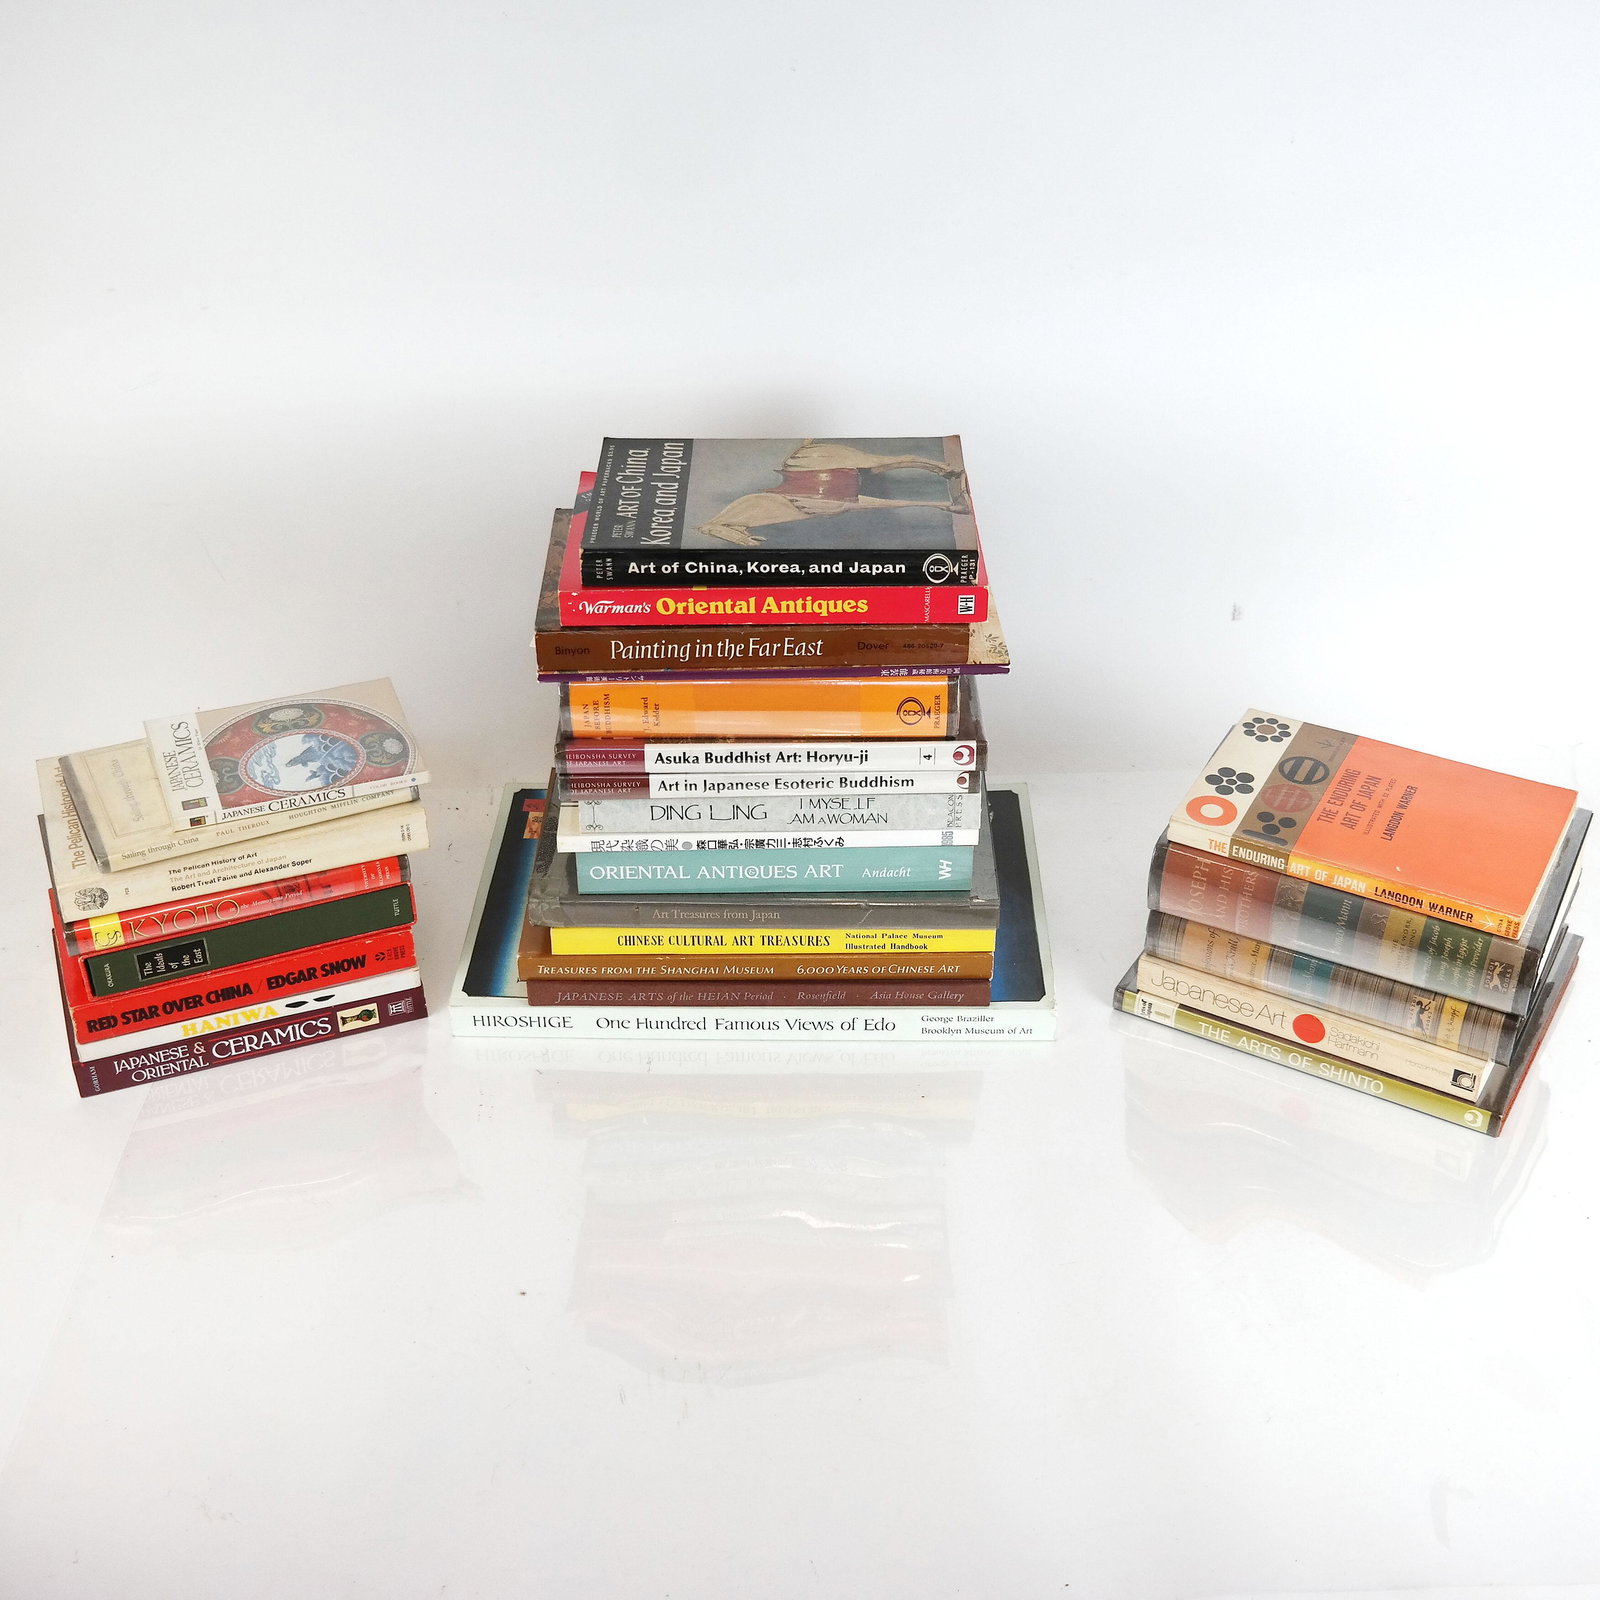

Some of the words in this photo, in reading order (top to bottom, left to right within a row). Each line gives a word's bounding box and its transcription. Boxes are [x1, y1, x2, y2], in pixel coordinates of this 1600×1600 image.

[615, 447, 652, 484] China,
[652, 442, 688, 479] Japan
[622, 485, 642, 498] OF
[651, 480, 679, 505] and
[616, 499, 640, 518] ART
[611, 523, 624, 538] PETER
[640, 507, 678, 545] Korea,
[596, 559, 604, 579] PETER
[606, 557, 614, 581] SWANN
[628, 561, 656, 574] Art
[661, 561, 679, 574] of
[685, 561, 743, 576] China,
[747, 561, 805, 576] Korea,
[809, 561, 843, 574] and
[849, 561, 906, 576] Japan
[960, 554, 968, 583] PRAEGER
[578, 600, 652, 615] Warman's
[656, 597, 756, 616] Oriental
[761, 596, 869, 617] Antiques
[555, 645, 590, 656] Binyon
[610, 639, 690, 662] Painting
[694, 639, 712, 658] in
[716, 638, 744, 660] the
[748, 637, 781, 657] Far
[783, 637, 824, 658] East
[857, 641, 889, 651] Dover
[583, 702, 591, 728] JAPAN
[608, 752, 637, 760] SURVEY
[654, 751, 700, 765] Asuka
[704, 751, 771, 765] Buddhist
[775, 751, 802, 763] Art:
[806, 750, 869, 766] Horyu-ji
[657, 780, 680, 792] Art
[683, 780, 698, 792] in
[702, 779, 770, 794] Japanese
[774, 776, 835, 790] Esoteric
[839, 775, 915, 789] Buddhism
[1326, 768, 1361, 806] ENDURING
[1356, 774, 1382, 801] JAPAN
[221, 805, 265, 821] JAPANESE
[268, 788, 346, 812] CERAMICS
[650, 804, 702, 822] DING
[710, 804, 768, 822] LING
[808, 797, 876, 810] MYSELF
[1349, 799, 1368, 812] OF
[1380, 810, 1405, 842] LANGDON
[1396, 784, 1418, 810] WARNER
[787, 813, 815, 825] AM
[827, 812, 888, 825] WOMAN
[1316, 805, 1339, 824] THE
[1340, 811, 1361, 831] ART
[67, 815, 83, 850] Pelican
[216, 828, 234, 837] PAUL
[238, 820, 270, 833] THEROUX
[121, 849, 146, 861] Sailing
[147, 841, 176, 853] through
[177, 835, 199, 846] China
[72, 851, 87, 870] The
[168, 867, 182, 876] The
[183, 861, 210, 873] Pelican
[211, 856, 237, 867] History
[237, 854, 245, 862] of
[246, 852, 258, 860] Art
[171, 881, 196, 892] Robert
[253, 863, 290, 876] Alexander
[291, 858, 313, 869] Soper
[590, 865, 690, 881] ORIENTAL
[697, 865, 798, 880] ANTIQUES
[804, 864, 844, 878] ART
[862, 867, 911, 878] Andacht
[1208, 838, 1228, 855] THE
[1231, 845, 1285, 870] ENDURING
[1289, 862, 1312, 878] ART
[1314, 869, 1329, 881] OF
[1332, 873, 1367, 893] JAPAN
[1373, 885, 1424, 909] LANGDON
[1428, 901, 1474, 923] WARNER
[1222, 866, 1234, 891] HIS
[130, 899, 240, 941] KYOTO
[652, 909, 669, 919] Art
[671, 908, 721, 919] Treasures
[723, 908, 748, 919] from
[749, 909, 780, 922] Japan
[617, 935, 664, 947] CHINESE
[668, 935, 727, 947] CULTURAL
[731, 935, 755, 947] ART
[761, 935, 830, 947] TREASURES
[881, 932, 908, 940] Palace
[912, 932, 944, 940] Museum
[154, 952, 166, 973] Ideals
[171, 961, 179, 970] of
[183, 953, 191, 967] the
[193, 948, 203, 964] East
[144, 962, 153, 977] The
[796, 965, 835, 976] 6,000
[86, 1013, 119, 1034] RED
[121, 1003, 161, 1026] STAR
[161, 993, 204, 1016] OVER
[205, 982, 253, 1005] CHINA
[266, 967, 319, 991] EDGAR
[320, 954, 367, 978] SNOW
[555, 992, 623, 1003] JAPANESE
[628, 992, 664, 1002] ARTS
[667, 991, 677, 1003] of
[679, 991, 694, 1002] the
[698, 991, 741, 1002] HEIAN
[743, 991, 774, 1002] Period
[797, 990, 846, 1003] Rosenfield
[870, 990, 892, 1000] Asia
[895, 990, 925, 1000] House
[928, 990, 965, 1003] Gallery
[1150, 969, 1255, 1017] Japanese
[1254, 1003, 1288, 1030] Art
[180, 1005, 280, 1038] HANIWA
[473, 1015, 574, 1029] HIROSHIGE
[596, 1016, 631, 1030] One
[636, 1016, 707, 1030] Hundred
[715, 1017, 780, 1031] Famous
[785, 1017, 834, 1031] Views
[840, 1016, 858, 1031] of
[863, 1017, 896, 1032] Edo
[921, 1015, 954, 1024] George
[956, 1014, 995, 1023] Braziller
[211, 1017, 332, 1060] CERAMICS
[921, 1026, 962, 1036] Brooklyn
[965, 1027, 1004, 1035] Museum
[1007, 1026, 1017, 1035] of
[1019, 1026, 1033, 1035] Art
[1328, 1025, 1382, 1051] Sadakichi
[113, 1044, 190, 1075] JAPANESE
[193, 1041, 207, 1055] &
[1198, 1020, 1231, 1044] THE
[1237, 1034, 1283, 1061] ARTS
[1287, 1052, 1313, 1069] OF
[1318, 1062, 1385, 1095] SHINTO
[1326, 1035, 1380, 1062] Hartmann
[90, 1065, 100, 1092] GORHAM
[131, 1056, 209, 1083] ORIENTAL
